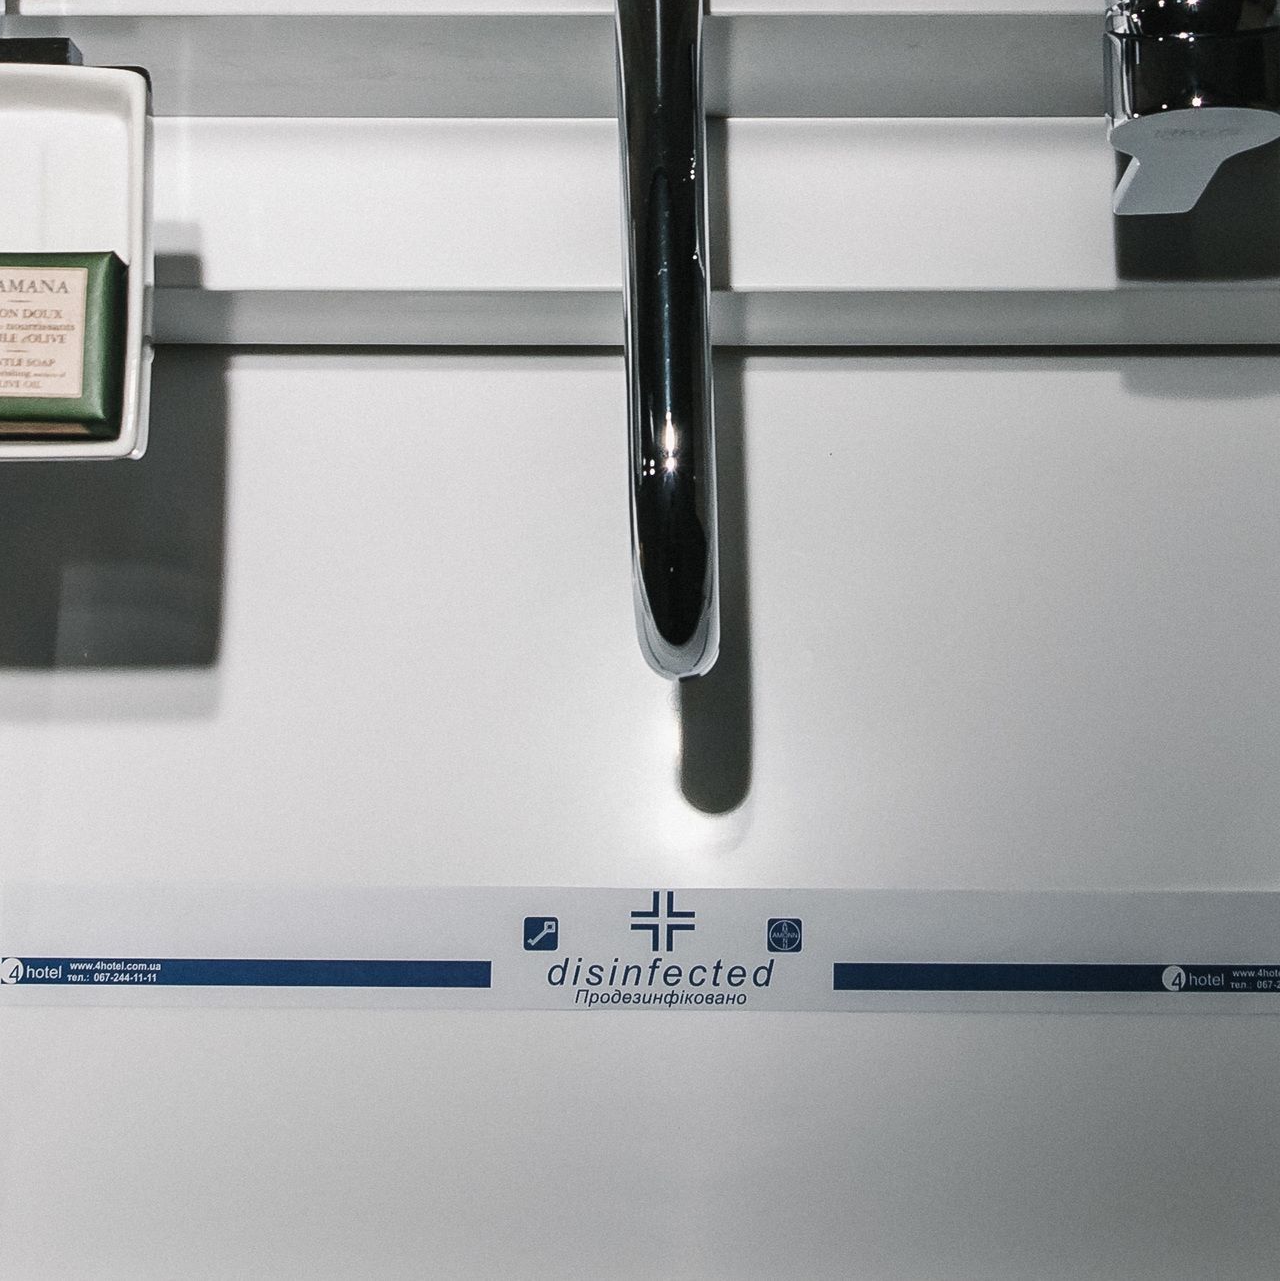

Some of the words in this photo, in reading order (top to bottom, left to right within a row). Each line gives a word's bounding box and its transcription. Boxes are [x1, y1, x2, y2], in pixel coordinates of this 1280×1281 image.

[22, 309, 63, 319] DOUX
[26, 965, 62, 979] hotel
[70, 961, 161, 971] www.4hotel.com.ua
[547, 957, 775, 987] disinfected
[93, 973, 157, 982] 067-244-11-11
[1189, 972, 1224, 986] hotel
[575, 989, 747, 1008] Продезинфіковано
